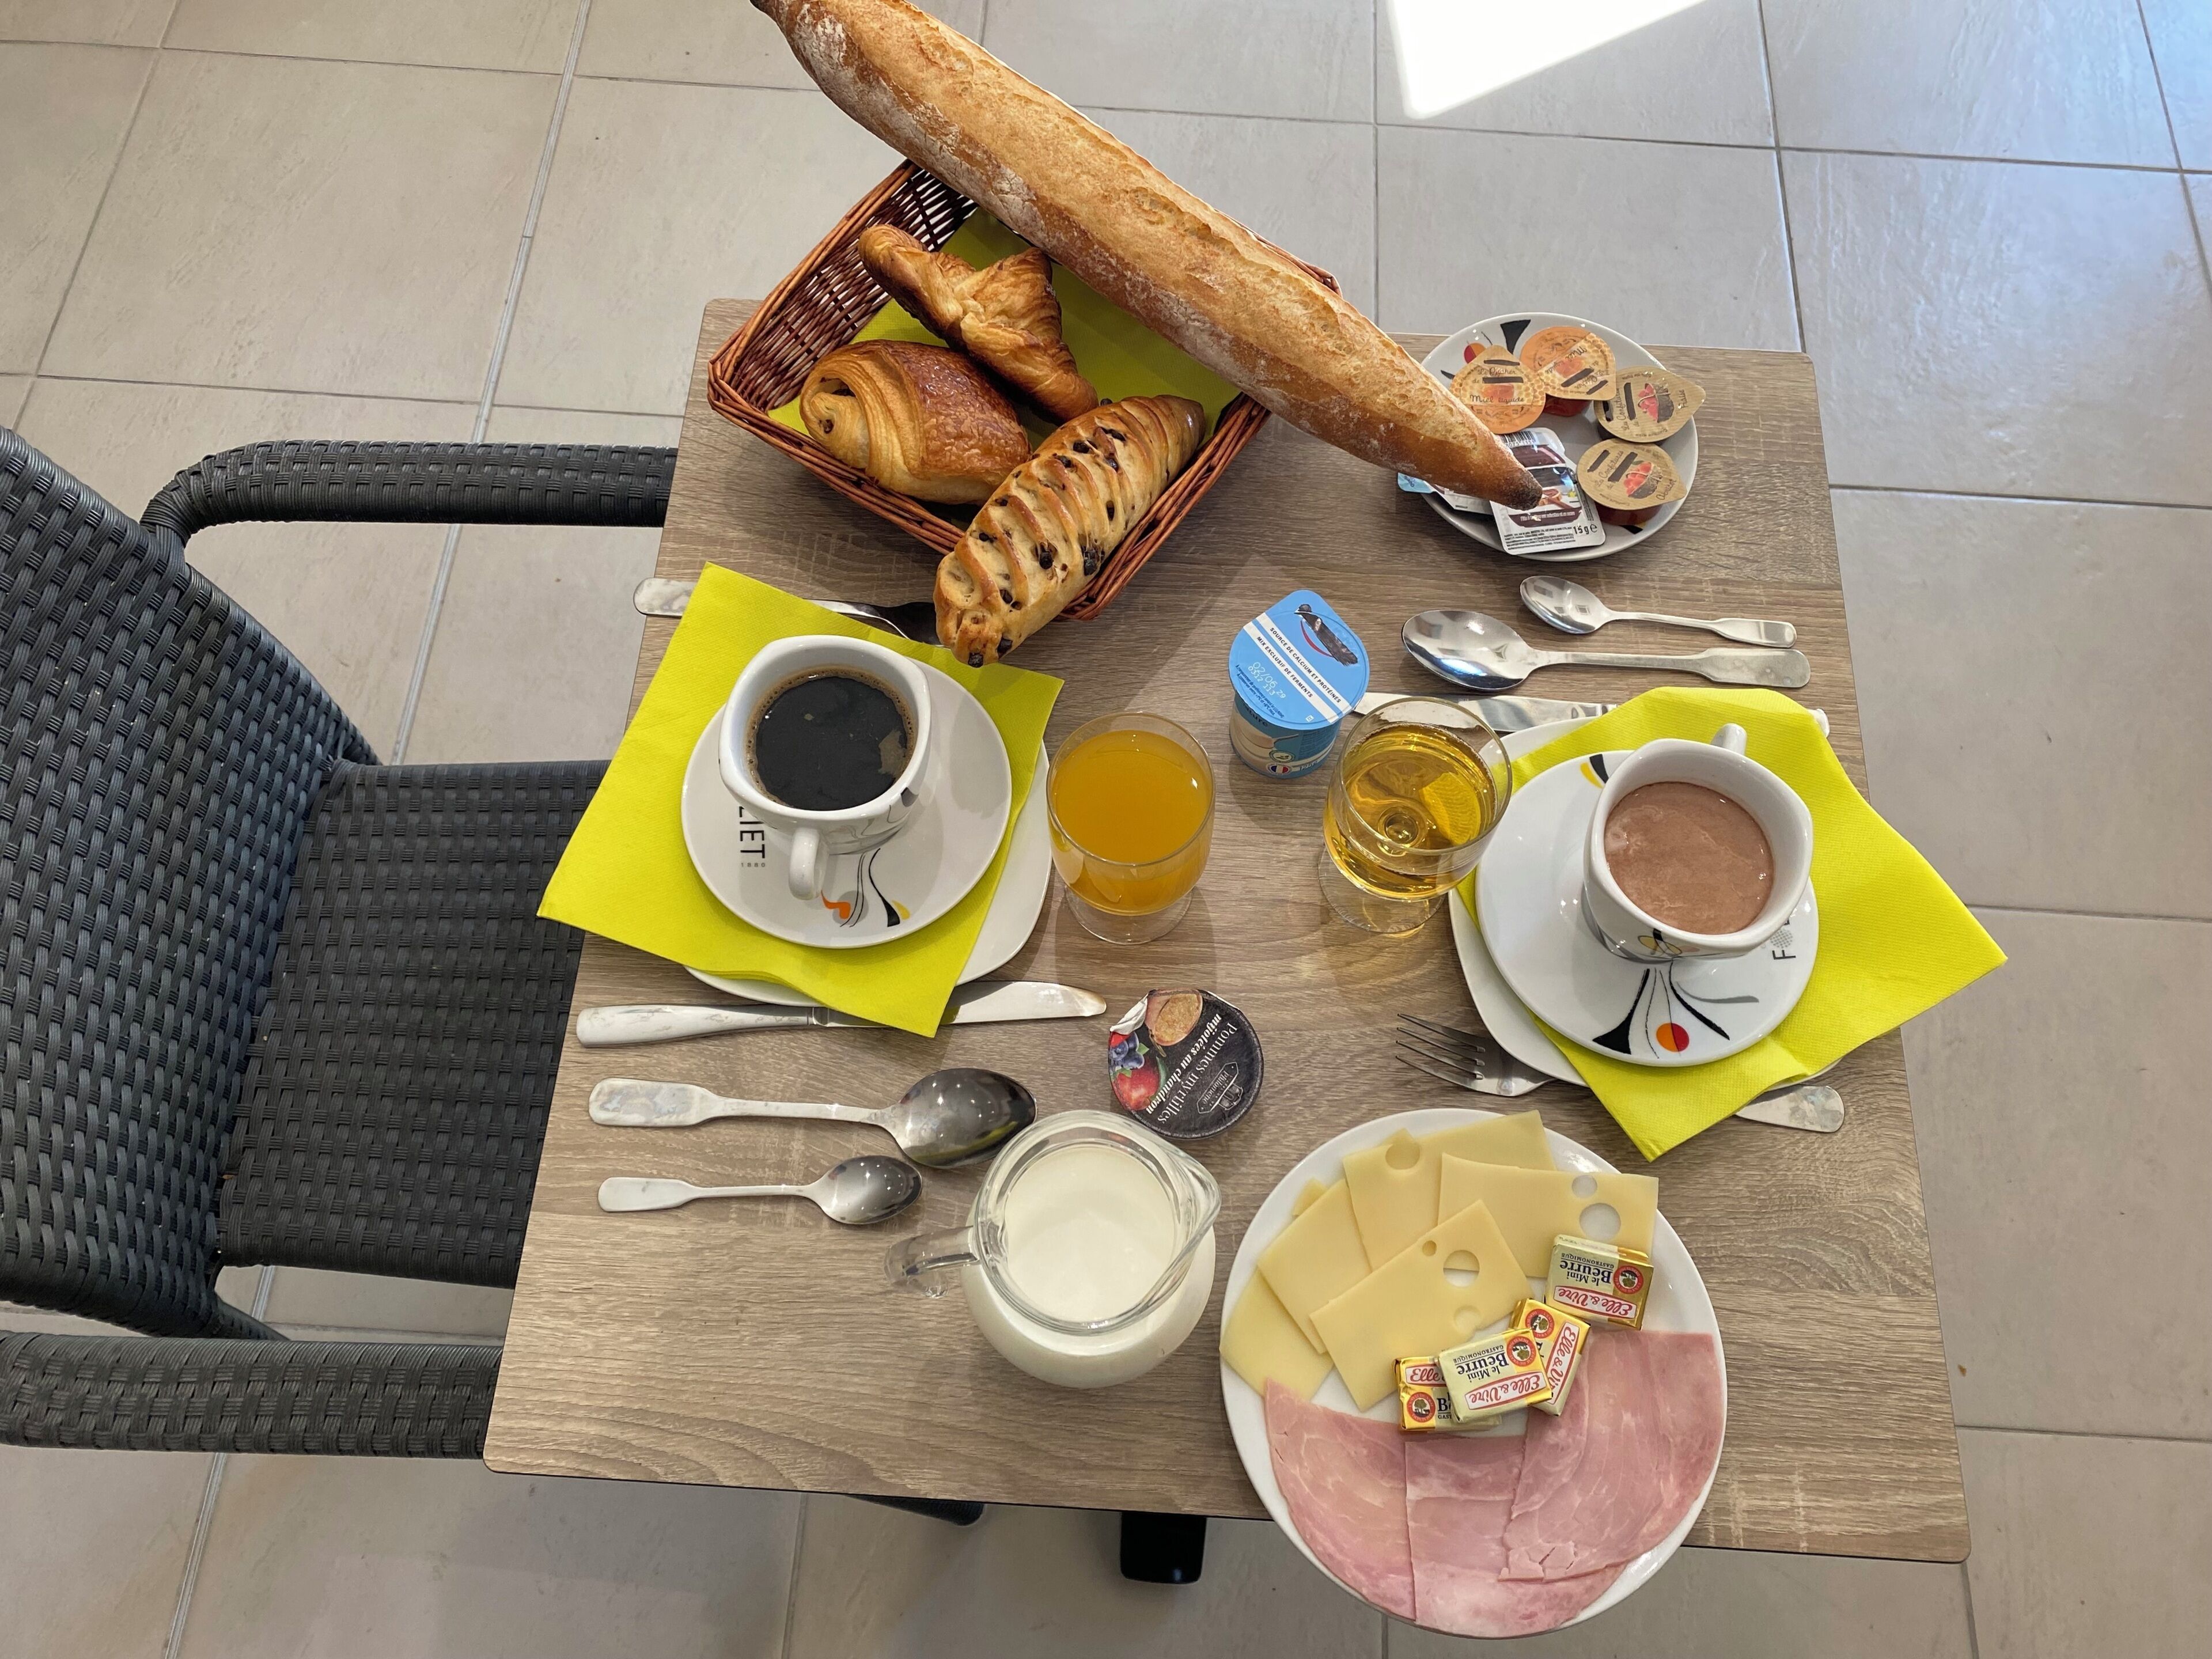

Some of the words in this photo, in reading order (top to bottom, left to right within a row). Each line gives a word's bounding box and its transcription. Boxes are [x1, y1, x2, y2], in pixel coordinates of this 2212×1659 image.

[1470, 394, 1494, 403] Miel
[1656, 479, 1677, 501] Abricot
[1257, 637, 1266, 646] MIX
[1265, 646, 1286, 668] EXCLUSIF
[1284, 667, 1291, 675] DE
[1290, 674, 1313, 698] FERMENTS
[1270, 627, 1287, 647] SOURCE
[1286, 646, 1294, 654] DE
[1293, 653, 1312, 674] CALCIUM
[1317, 679, 1341, 703] PROTÉINES
[1253, 662, 1278, 688] 02/06
[1191, 1013, 1222, 1056] mijotées
[1196, 1022, 1238, 1073] Pommes
[1180, 1054, 1192, 1069] au
[1146, 1069, 1181, 1114] chaudron
[1157, 1073, 1199, 1124] myrtilles
[1561, 1252, 1615, 1269] GASTRONOMIQUE
[1560, 1260, 1613, 1284] Beurre
[1566, 1271, 1590, 1283] Mini
[1591, 1277, 1600, 1286] le
[1558, 1288, 1589, 1306] Vire
[1589, 1295, 1600, 1305] &
[1601, 1298, 1633, 1316] Elle
[1557, 1326, 1576, 1357] Elle
[1453, 1344, 1504, 1363] GASTRONOMIQUE
[1552, 1357, 1563, 1367] &
[1456, 1353, 1509, 1374] Beurre
[1492, 1366, 1500, 1374] le
[1410, 1368, 1440, 1382] Elle
[1467, 1368, 1491, 1382] Mini
[1510, 1374, 1540, 1393] Elle
[1469, 1388, 1501, 1403] Vire
[1498, 1384, 1509, 1393] &
